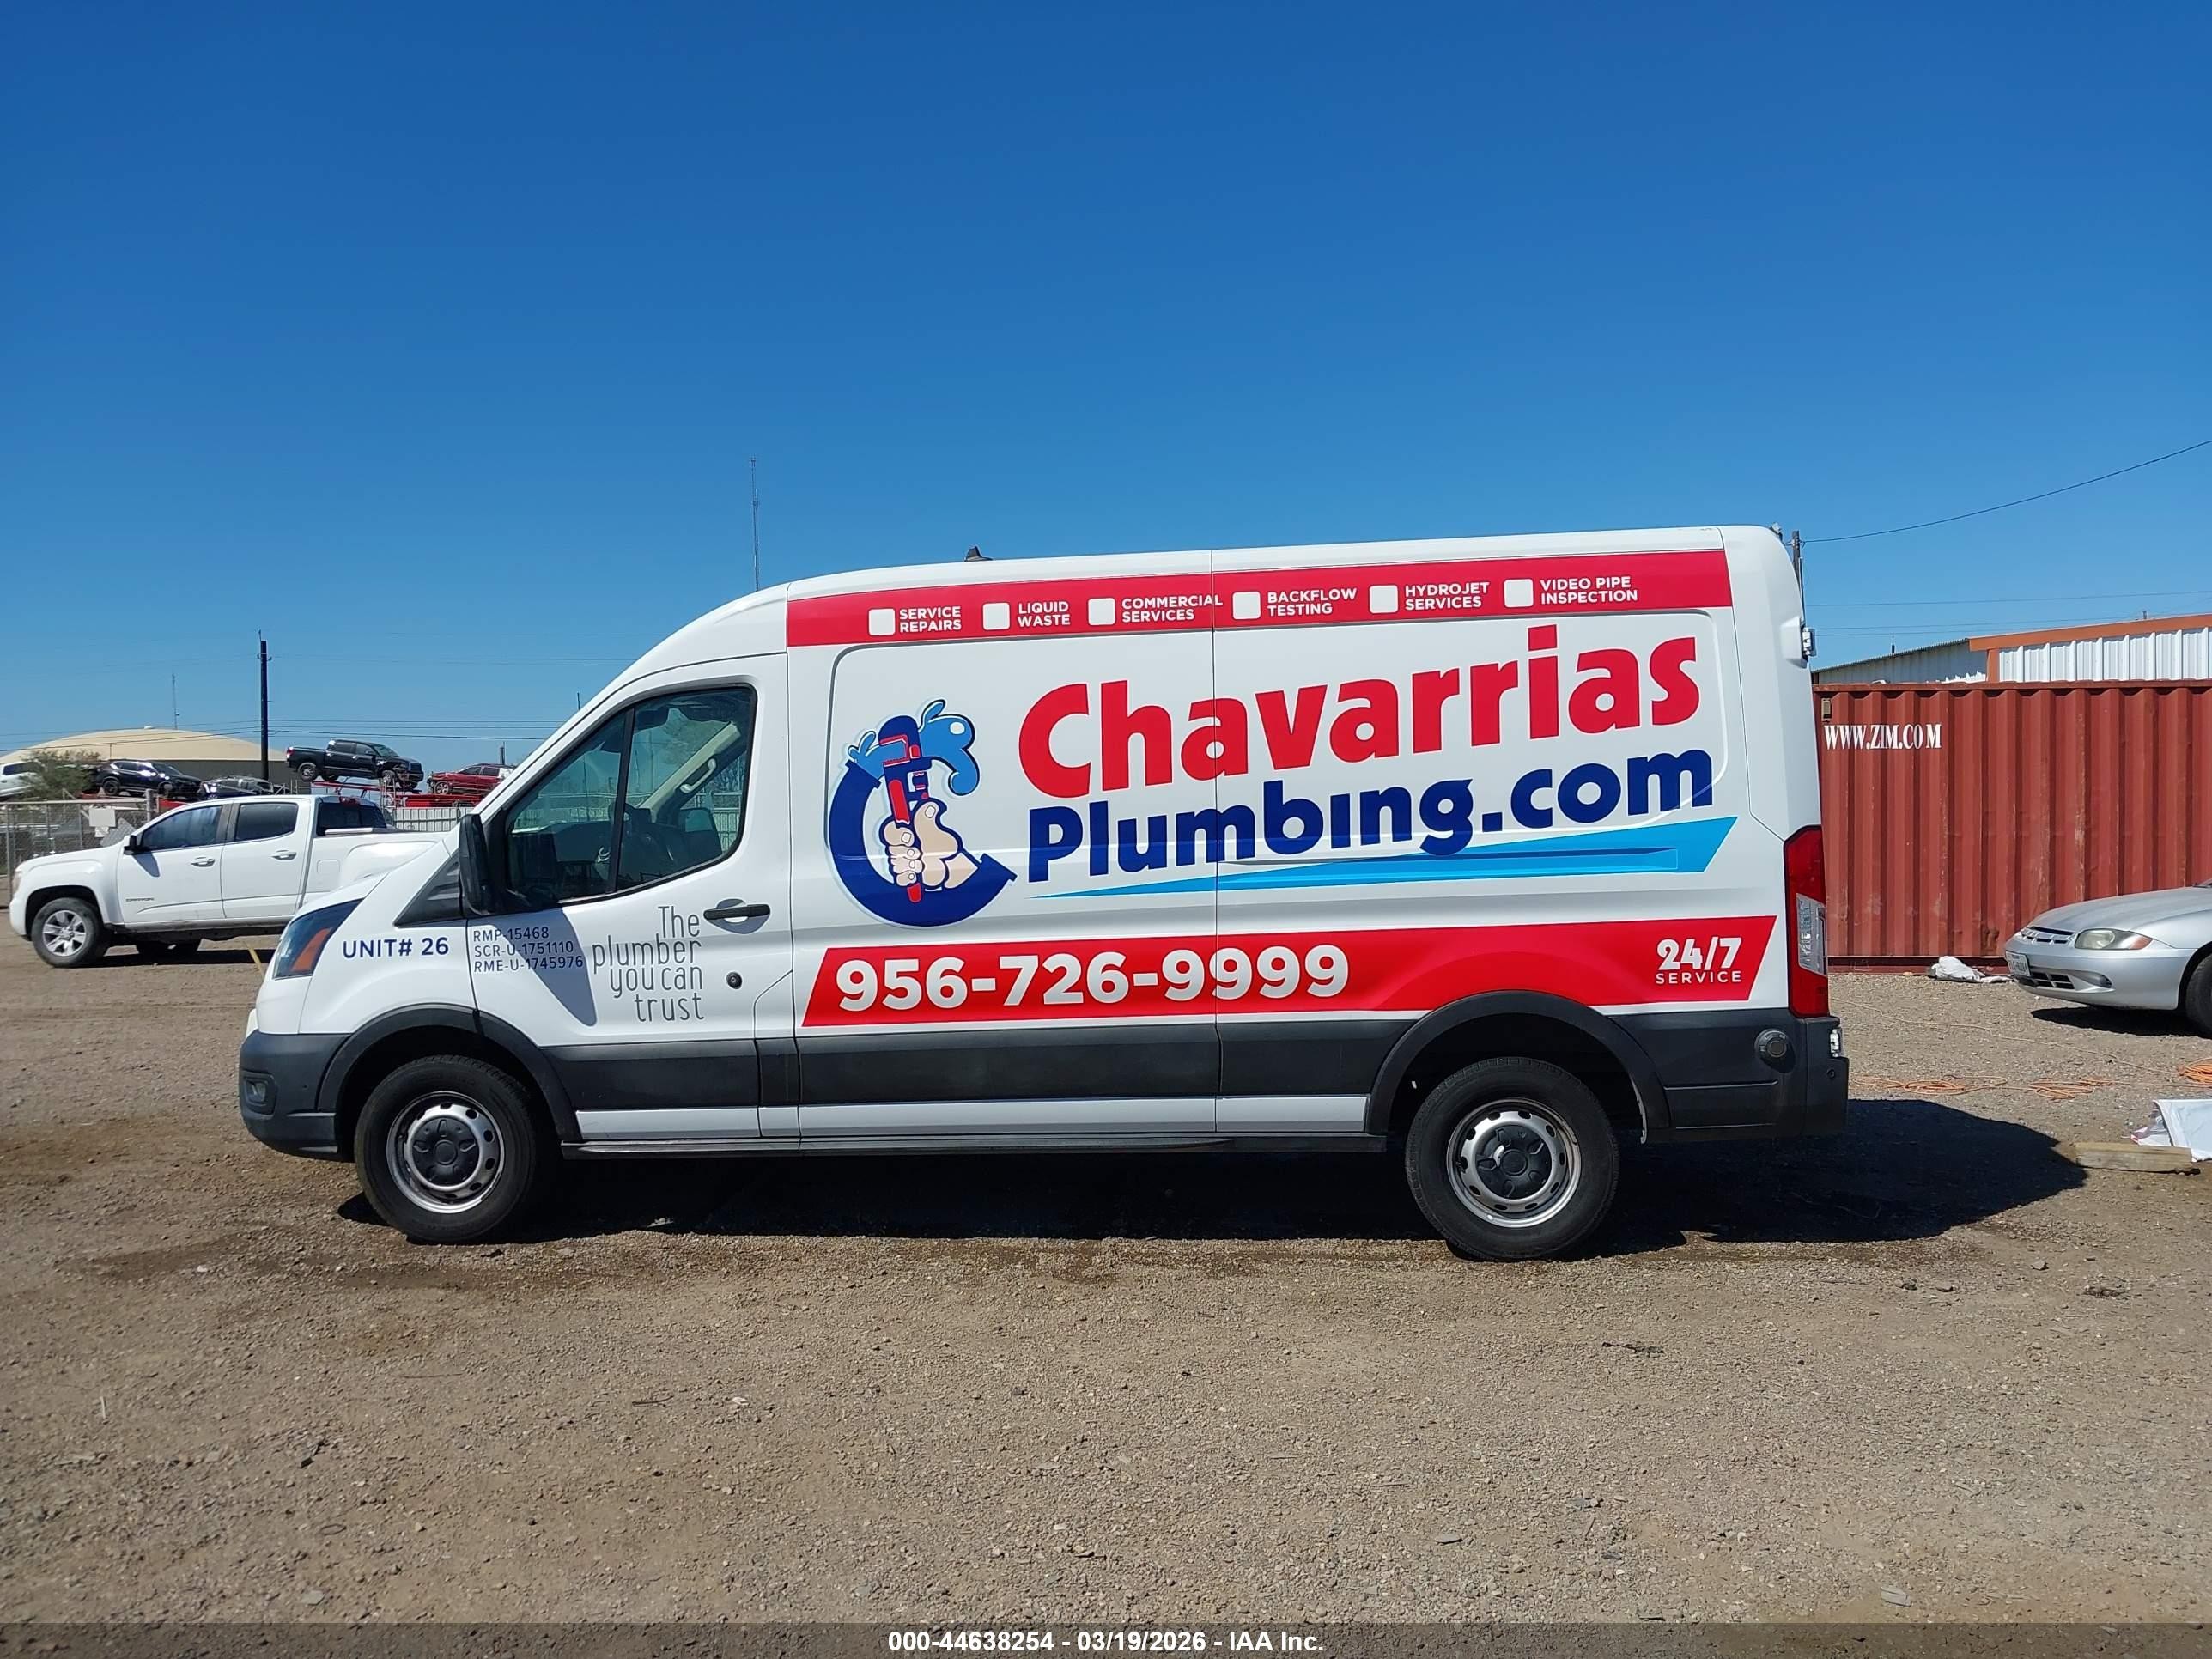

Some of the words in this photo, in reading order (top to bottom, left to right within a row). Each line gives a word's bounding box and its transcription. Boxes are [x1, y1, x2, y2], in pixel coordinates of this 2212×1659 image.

[1405, 581, 1490, 598] HYDROJET
[1540, 577, 1591, 591] VIDEO
[1596, 576, 1631, 589] PIPE
[1121, 594, 1224, 611] COMMERCIAL
[1267, 587, 1357, 604] BACKFLOW
[1405, 596, 1482, 611] SERVICES
[1540, 590, 1638, 605] INSPECTION
[899, 606, 962, 620] SERVICE
[1018, 601, 1069, 615] LIQUID
[1121, 609, 1195, 623] SERVICES
[1267, 603, 1333, 617] TESTING
[899, 619, 962, 633] REPAIRS
[1018, 614, 1071, 628] WASTE
[1018, 624, 1700, 799] Chavarrias
[1823, 723, 1942, 750] WWW.ZIM.COM
[1028, 748, 1714, 884] Plumbing.com
[658, 905, 700, 938] The
[473, 927, 549, 942] RMP-15468
[343, 939, 412, 959] UNIT#
[421, 937, 450, 956] 26
[474, 940, 574, 957] SCR-U-1751110
[592, 933, 702, 975] plumber
[1656, 936, 1742, 970] 24/7
[474, 955, 583, 972] RME-U-1745976
[610, 967, 654, 999] you
[661, 965, 703, 990] can
[835, 944, 1350, 1012] 956-726-9999
[1655, 970, 1742, 984] SERVICE
[634, 992, 704, 1022] trust
